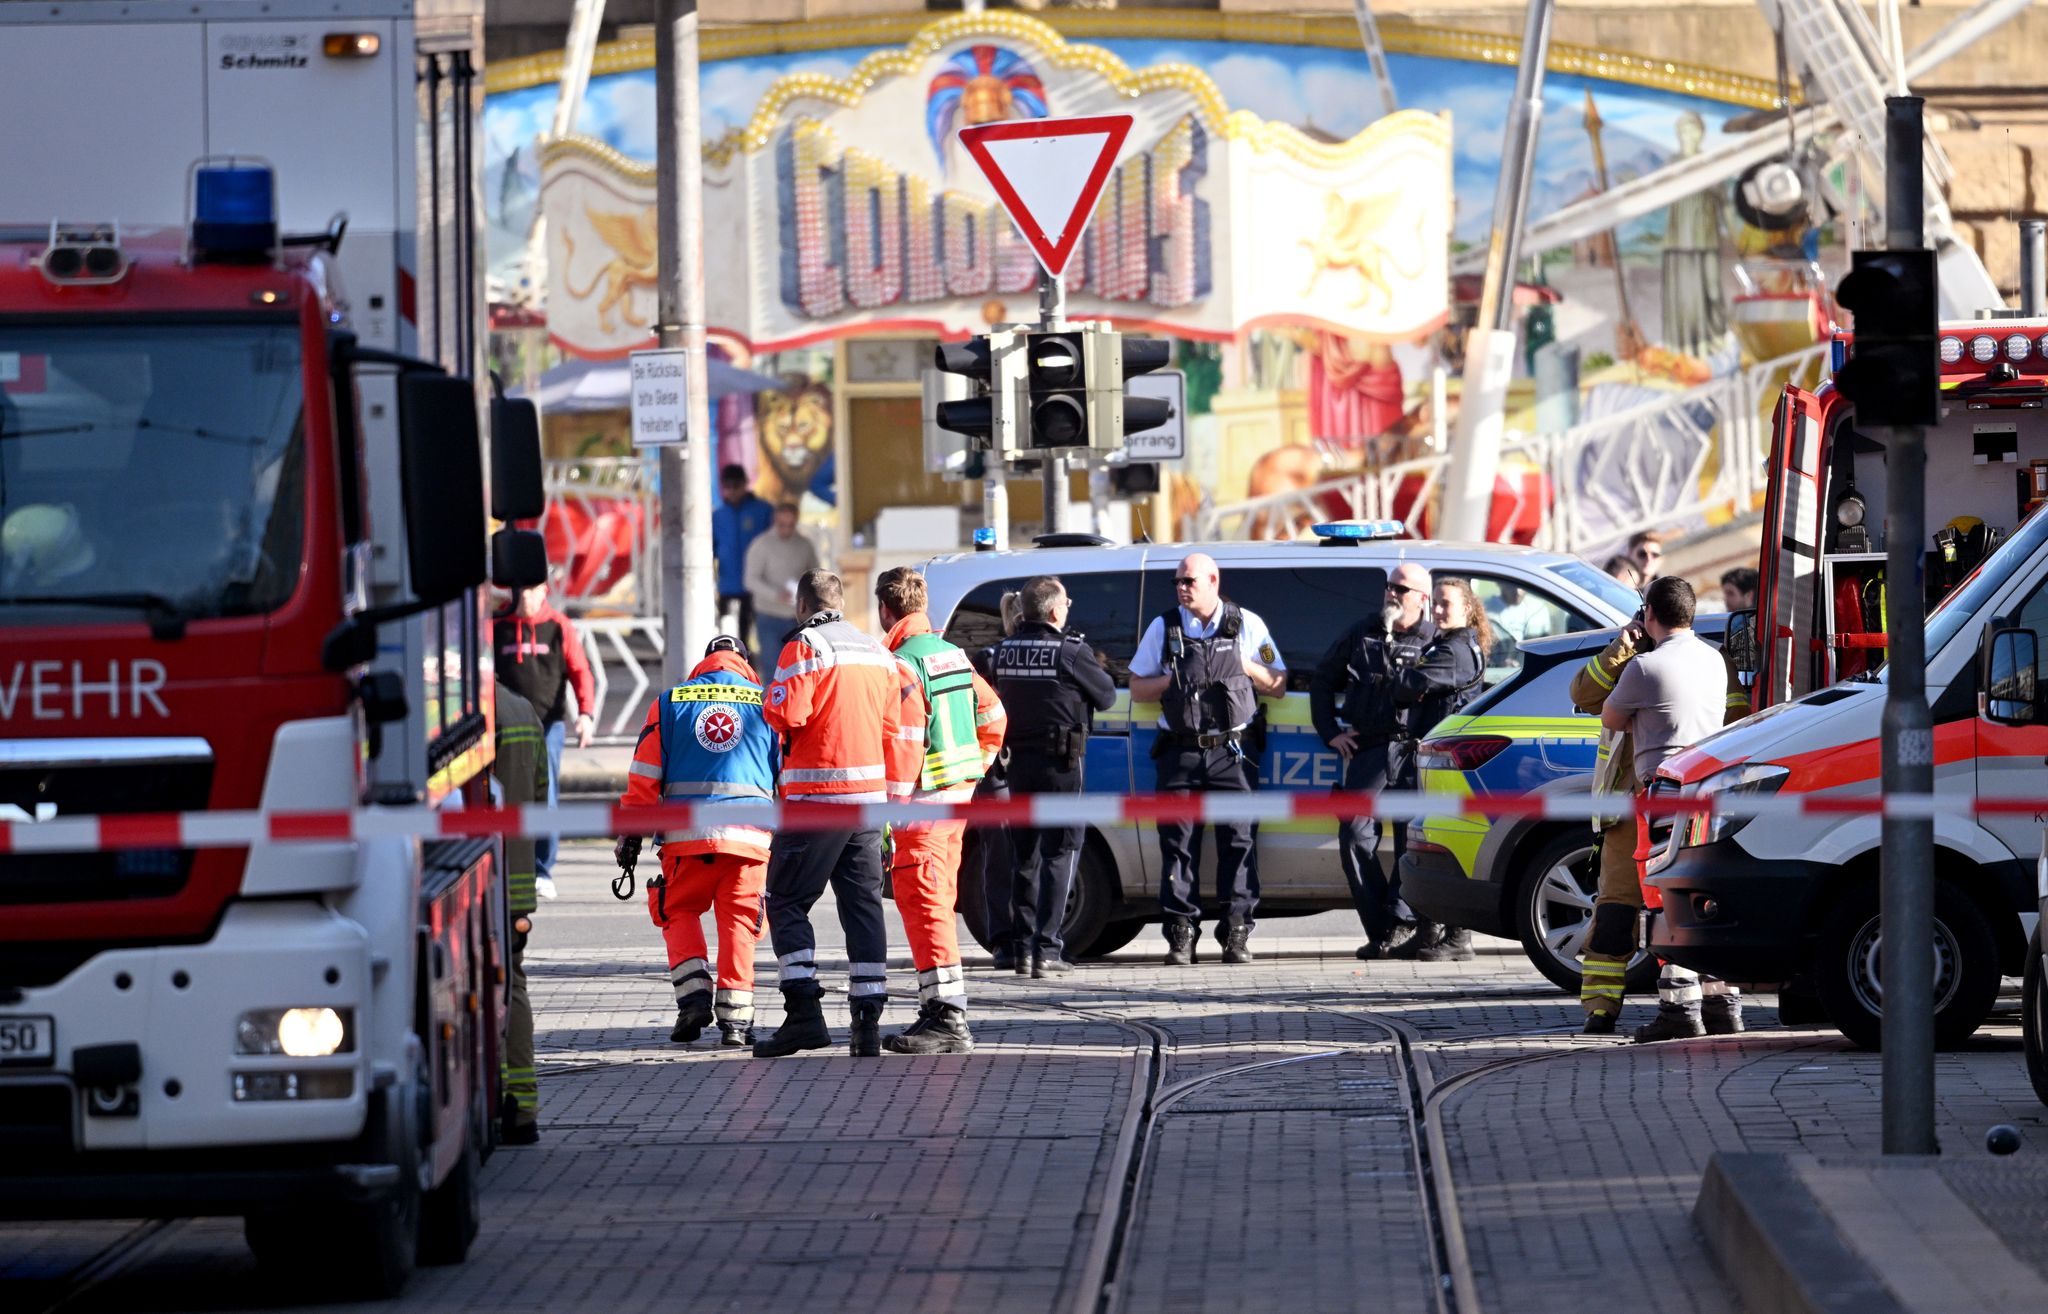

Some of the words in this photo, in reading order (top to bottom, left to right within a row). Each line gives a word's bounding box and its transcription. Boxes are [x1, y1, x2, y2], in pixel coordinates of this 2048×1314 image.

[220, 53, 309, 70] Schmitz
[997, 647, 1057, 667] POLIZEI
[700, 706, 740, 724] JOHANNITER
[699, 732, 739, 751] UNFALL-HILFE
